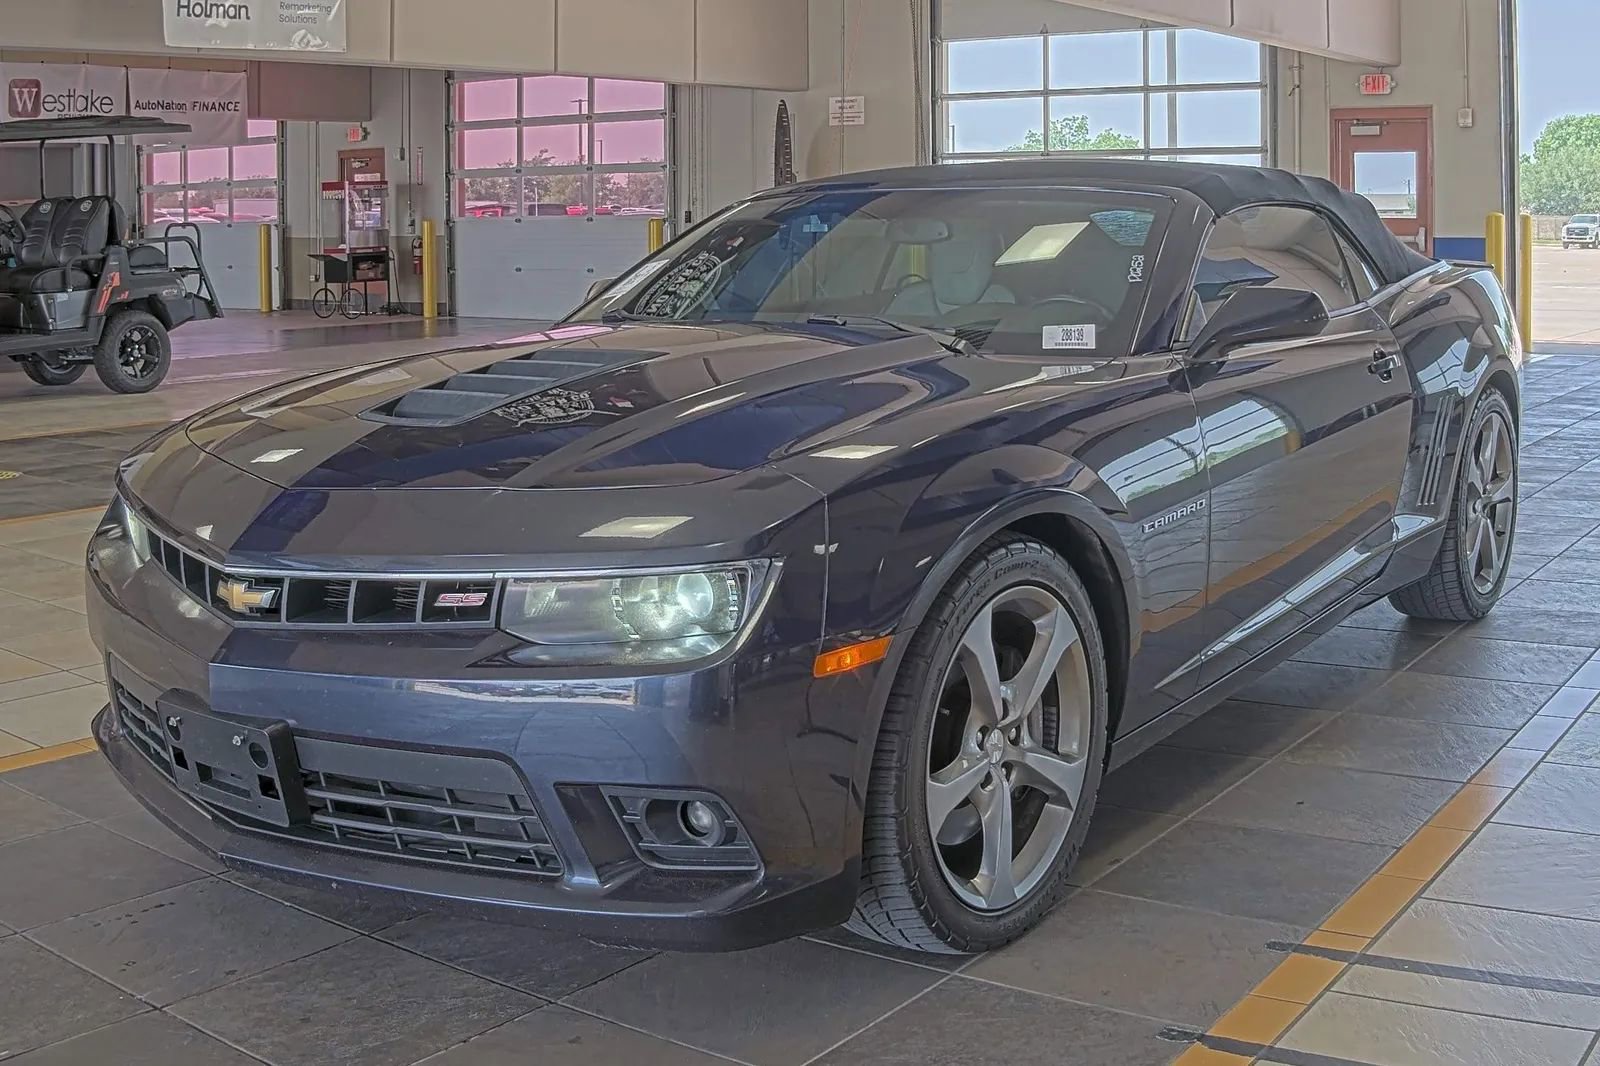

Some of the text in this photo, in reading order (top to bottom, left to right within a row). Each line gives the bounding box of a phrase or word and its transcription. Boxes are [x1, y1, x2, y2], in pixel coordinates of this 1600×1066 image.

[176, 0, 250, 20] Holman
[279, 1, 332, 15] Remarketing
[279, 15, 317, 24] Solutions
[1365, 75, 1386, 92] EXIT
[11, 87, 114, 114] Westlake
[134, 99, 240, 112] AutoNation FINANCE
[1061, 328, 1085, 342] 288139
[1143, 499, 1206, 533] CAMARO
[434, 593, 488, 607] SS
